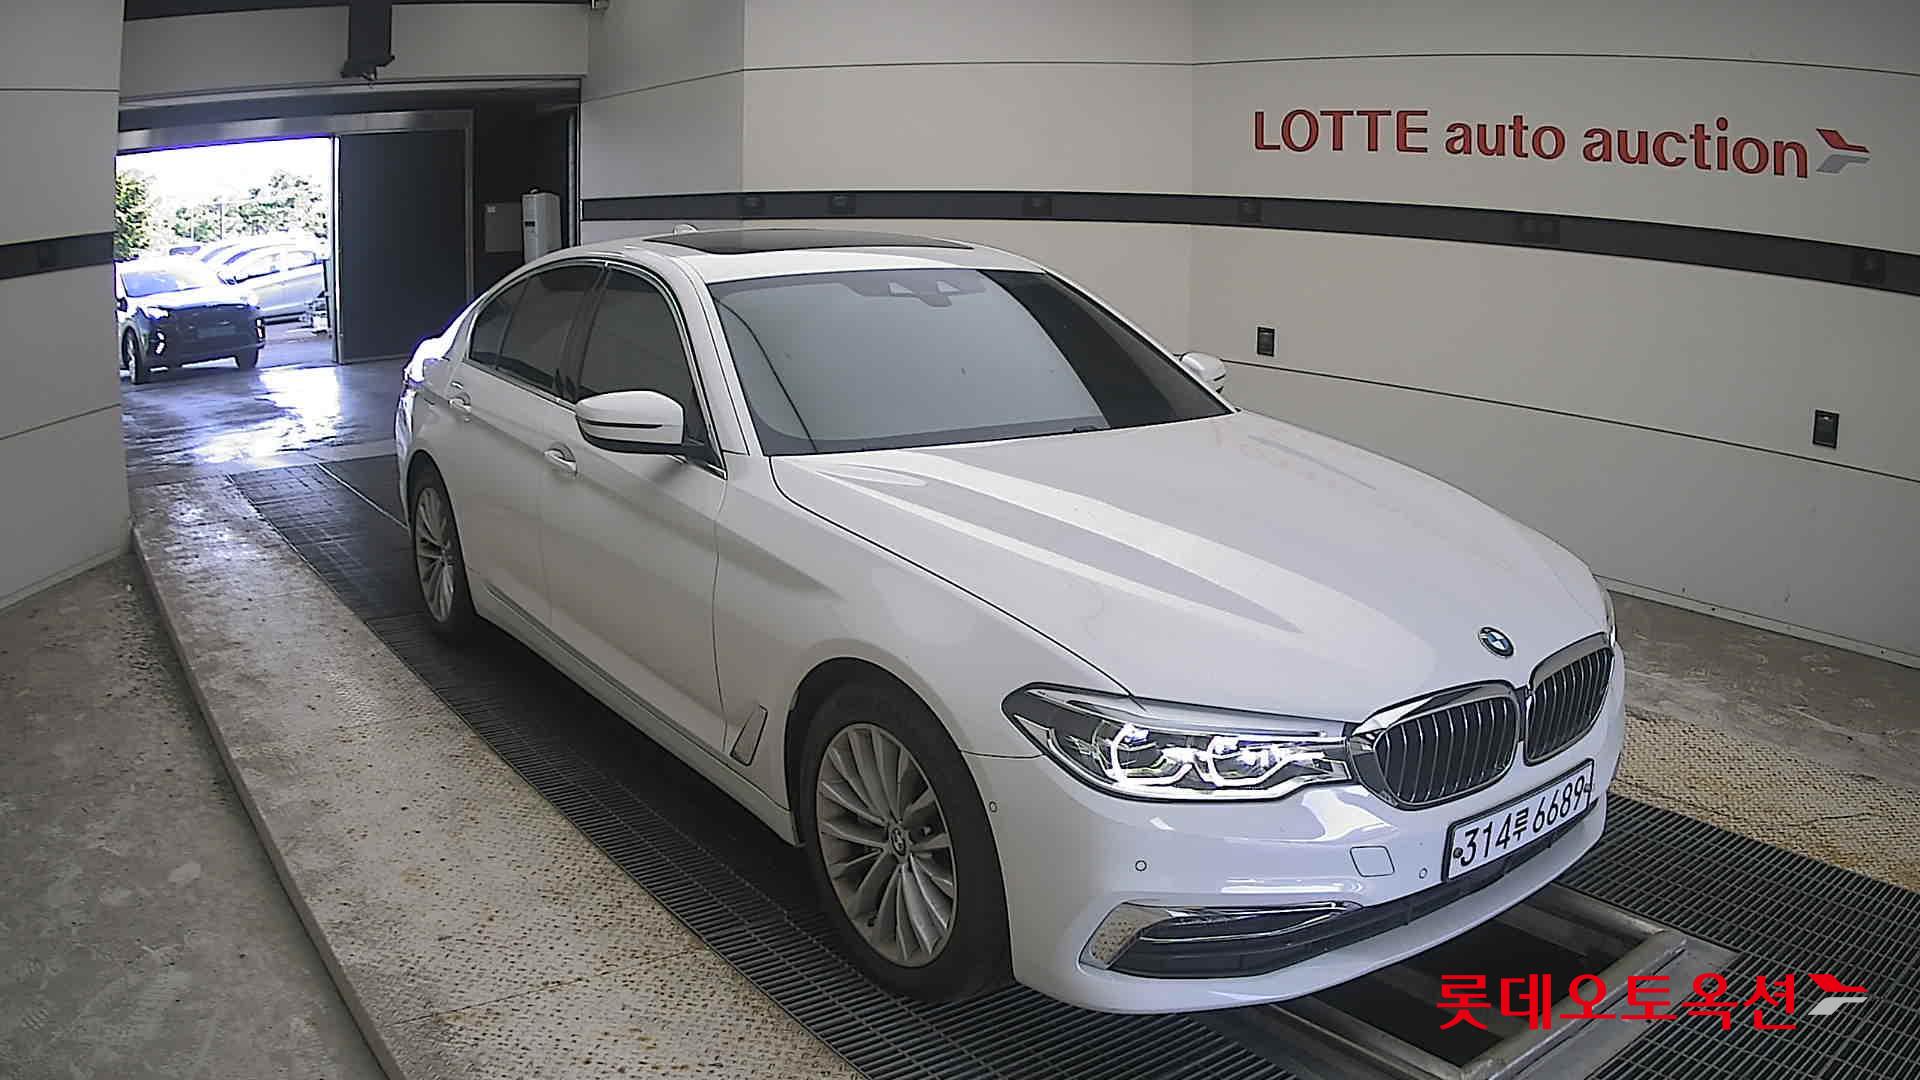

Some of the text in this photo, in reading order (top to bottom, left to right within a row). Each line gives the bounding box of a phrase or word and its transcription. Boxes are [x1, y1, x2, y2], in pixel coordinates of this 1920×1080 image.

[1253, 109, 1809, 179] LOTTE auto auction
[1460, 775, 1586, 867] 314루 6689
